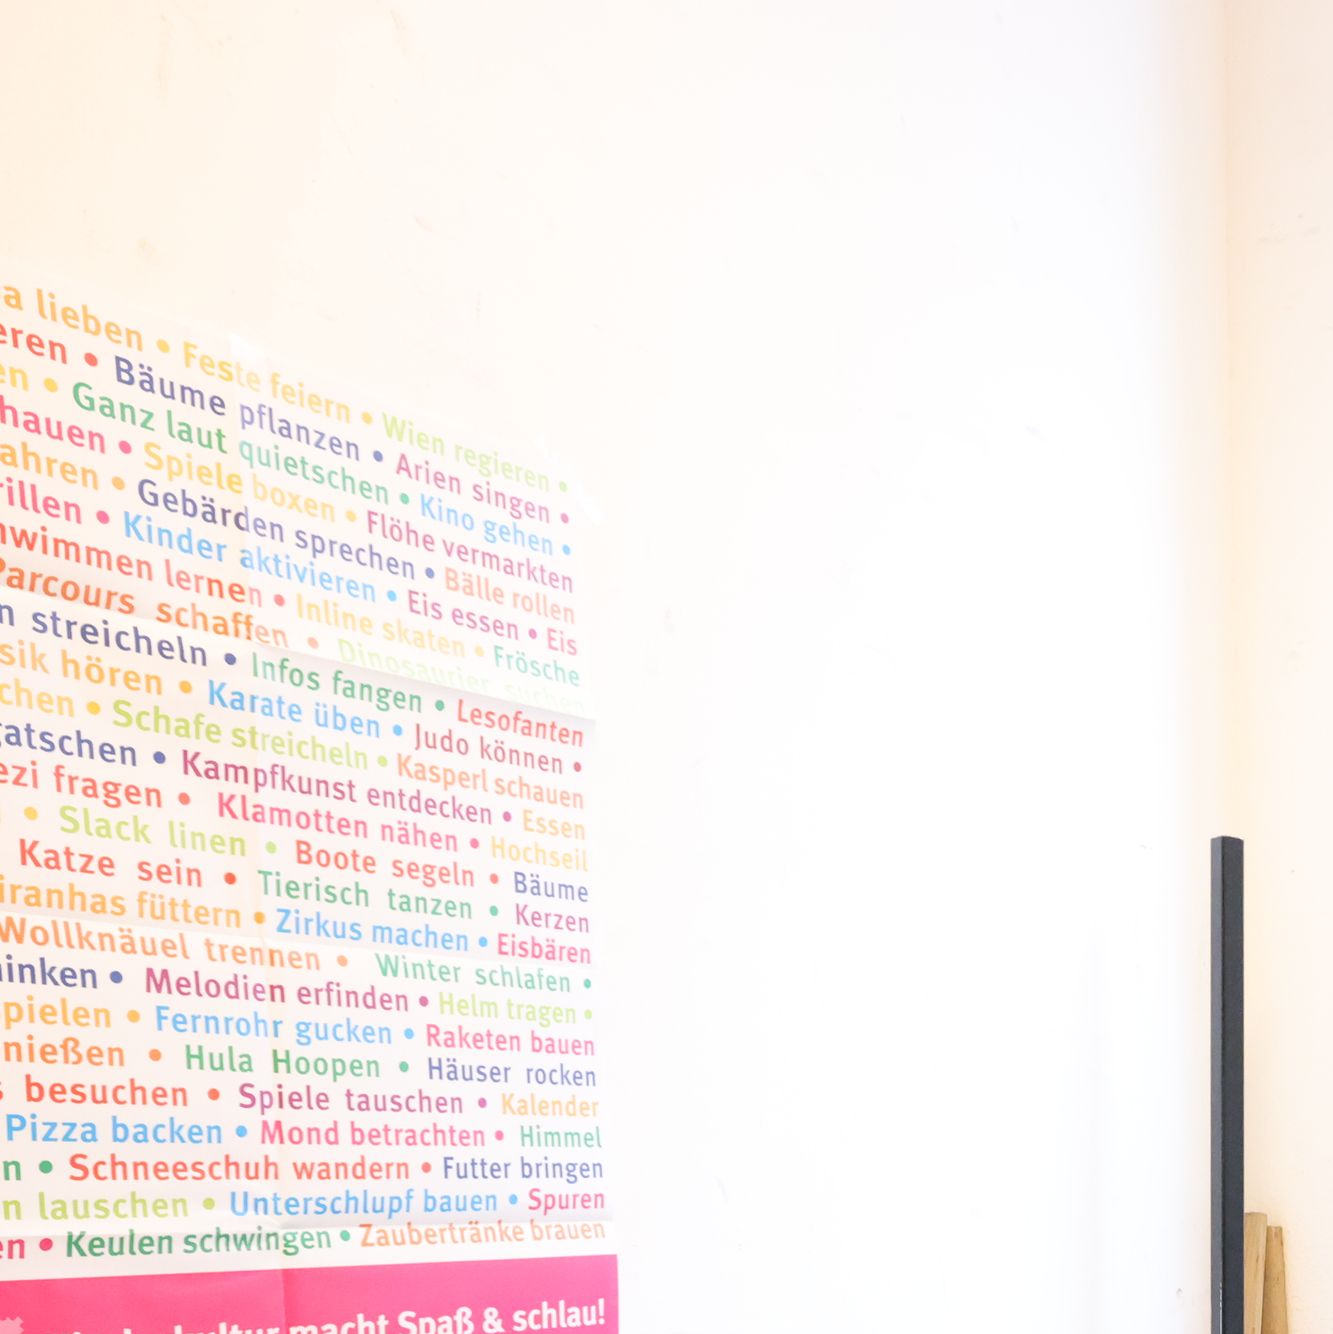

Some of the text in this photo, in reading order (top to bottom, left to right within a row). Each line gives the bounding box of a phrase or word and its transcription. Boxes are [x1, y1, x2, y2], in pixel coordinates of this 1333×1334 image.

[73, 382, 553, 556] Ganz laut quietschen Kino gehen
[115, 355, 550, 524] Bäume pflanzen Arien singen
[124, 511, 577, 656] Kinder aktivieren Eis essen Eis
[32, 611, 583, 747] streicheln Infos fangen Lesofanten
[61, 649, 562, 774] hören Karate üben Judo können
[182, 749, 587, 841] Kampfkunst entdecken Essen
[19, 838, 589, 933] Katze sein Tierisch tanzen Kerzen
[146, 967, 576, 1031] Melodien erfinden Helm tragen
[185, 1044, 597, 1089] Hula Hoopen Häuser rocken
[6, 1113, 602, 1149] Pizza backen Mond betrachten Himmel
[69, 1153, 603, 1184] Schneeschuh wandern Futter bringen
[483, 1307, 505, 1333] &
[513, 1298, 605, 1331] schlau!
